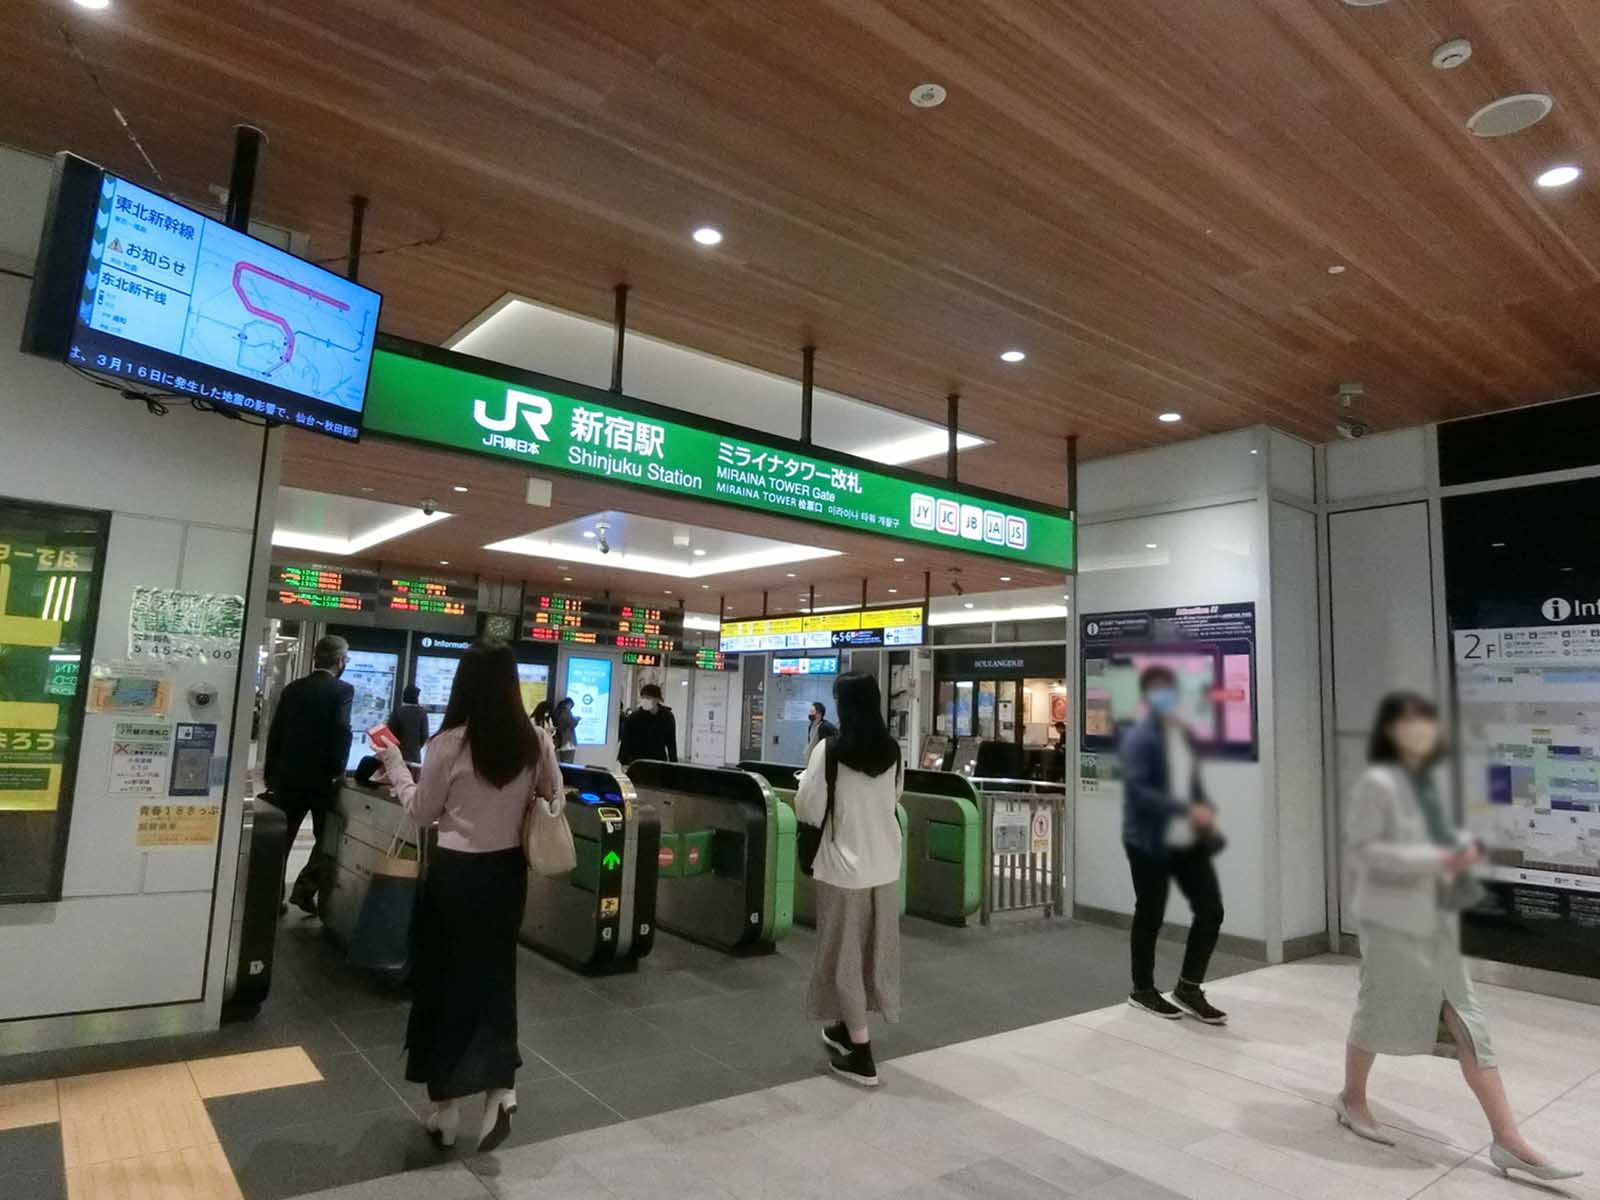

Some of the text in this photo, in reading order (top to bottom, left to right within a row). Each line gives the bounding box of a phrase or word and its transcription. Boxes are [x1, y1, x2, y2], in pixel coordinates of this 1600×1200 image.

[115, 194, 195, 241] 東北新幹線
[125, 242, 186, 277] お知らせ
[100, 271, 167, 306] 东北新干线
[474, 388, 553, 442] JR
[482, 433, 540, 455] JR東日本
[570, 406, 665, 459] 新宿駅
[568, 446, 702, 489] Shinjuku Station
[718, 442, 863, 494] ミライナタワー改札
[716, 465, 835, 502] MIRAINA TOWER Gate
[716, 482, 760, 499] MIRAINA
[762, 491, 797, 507] TOWER
[916, 505, 929, 519] JY
[942, 511, 953, 525] JC
[966, 517, 978, 530] JB
[988, 521, 1000, 534] JA
[1011, 526, 1021, 539] JS
[1464, 633, 1497, 659] 2F
